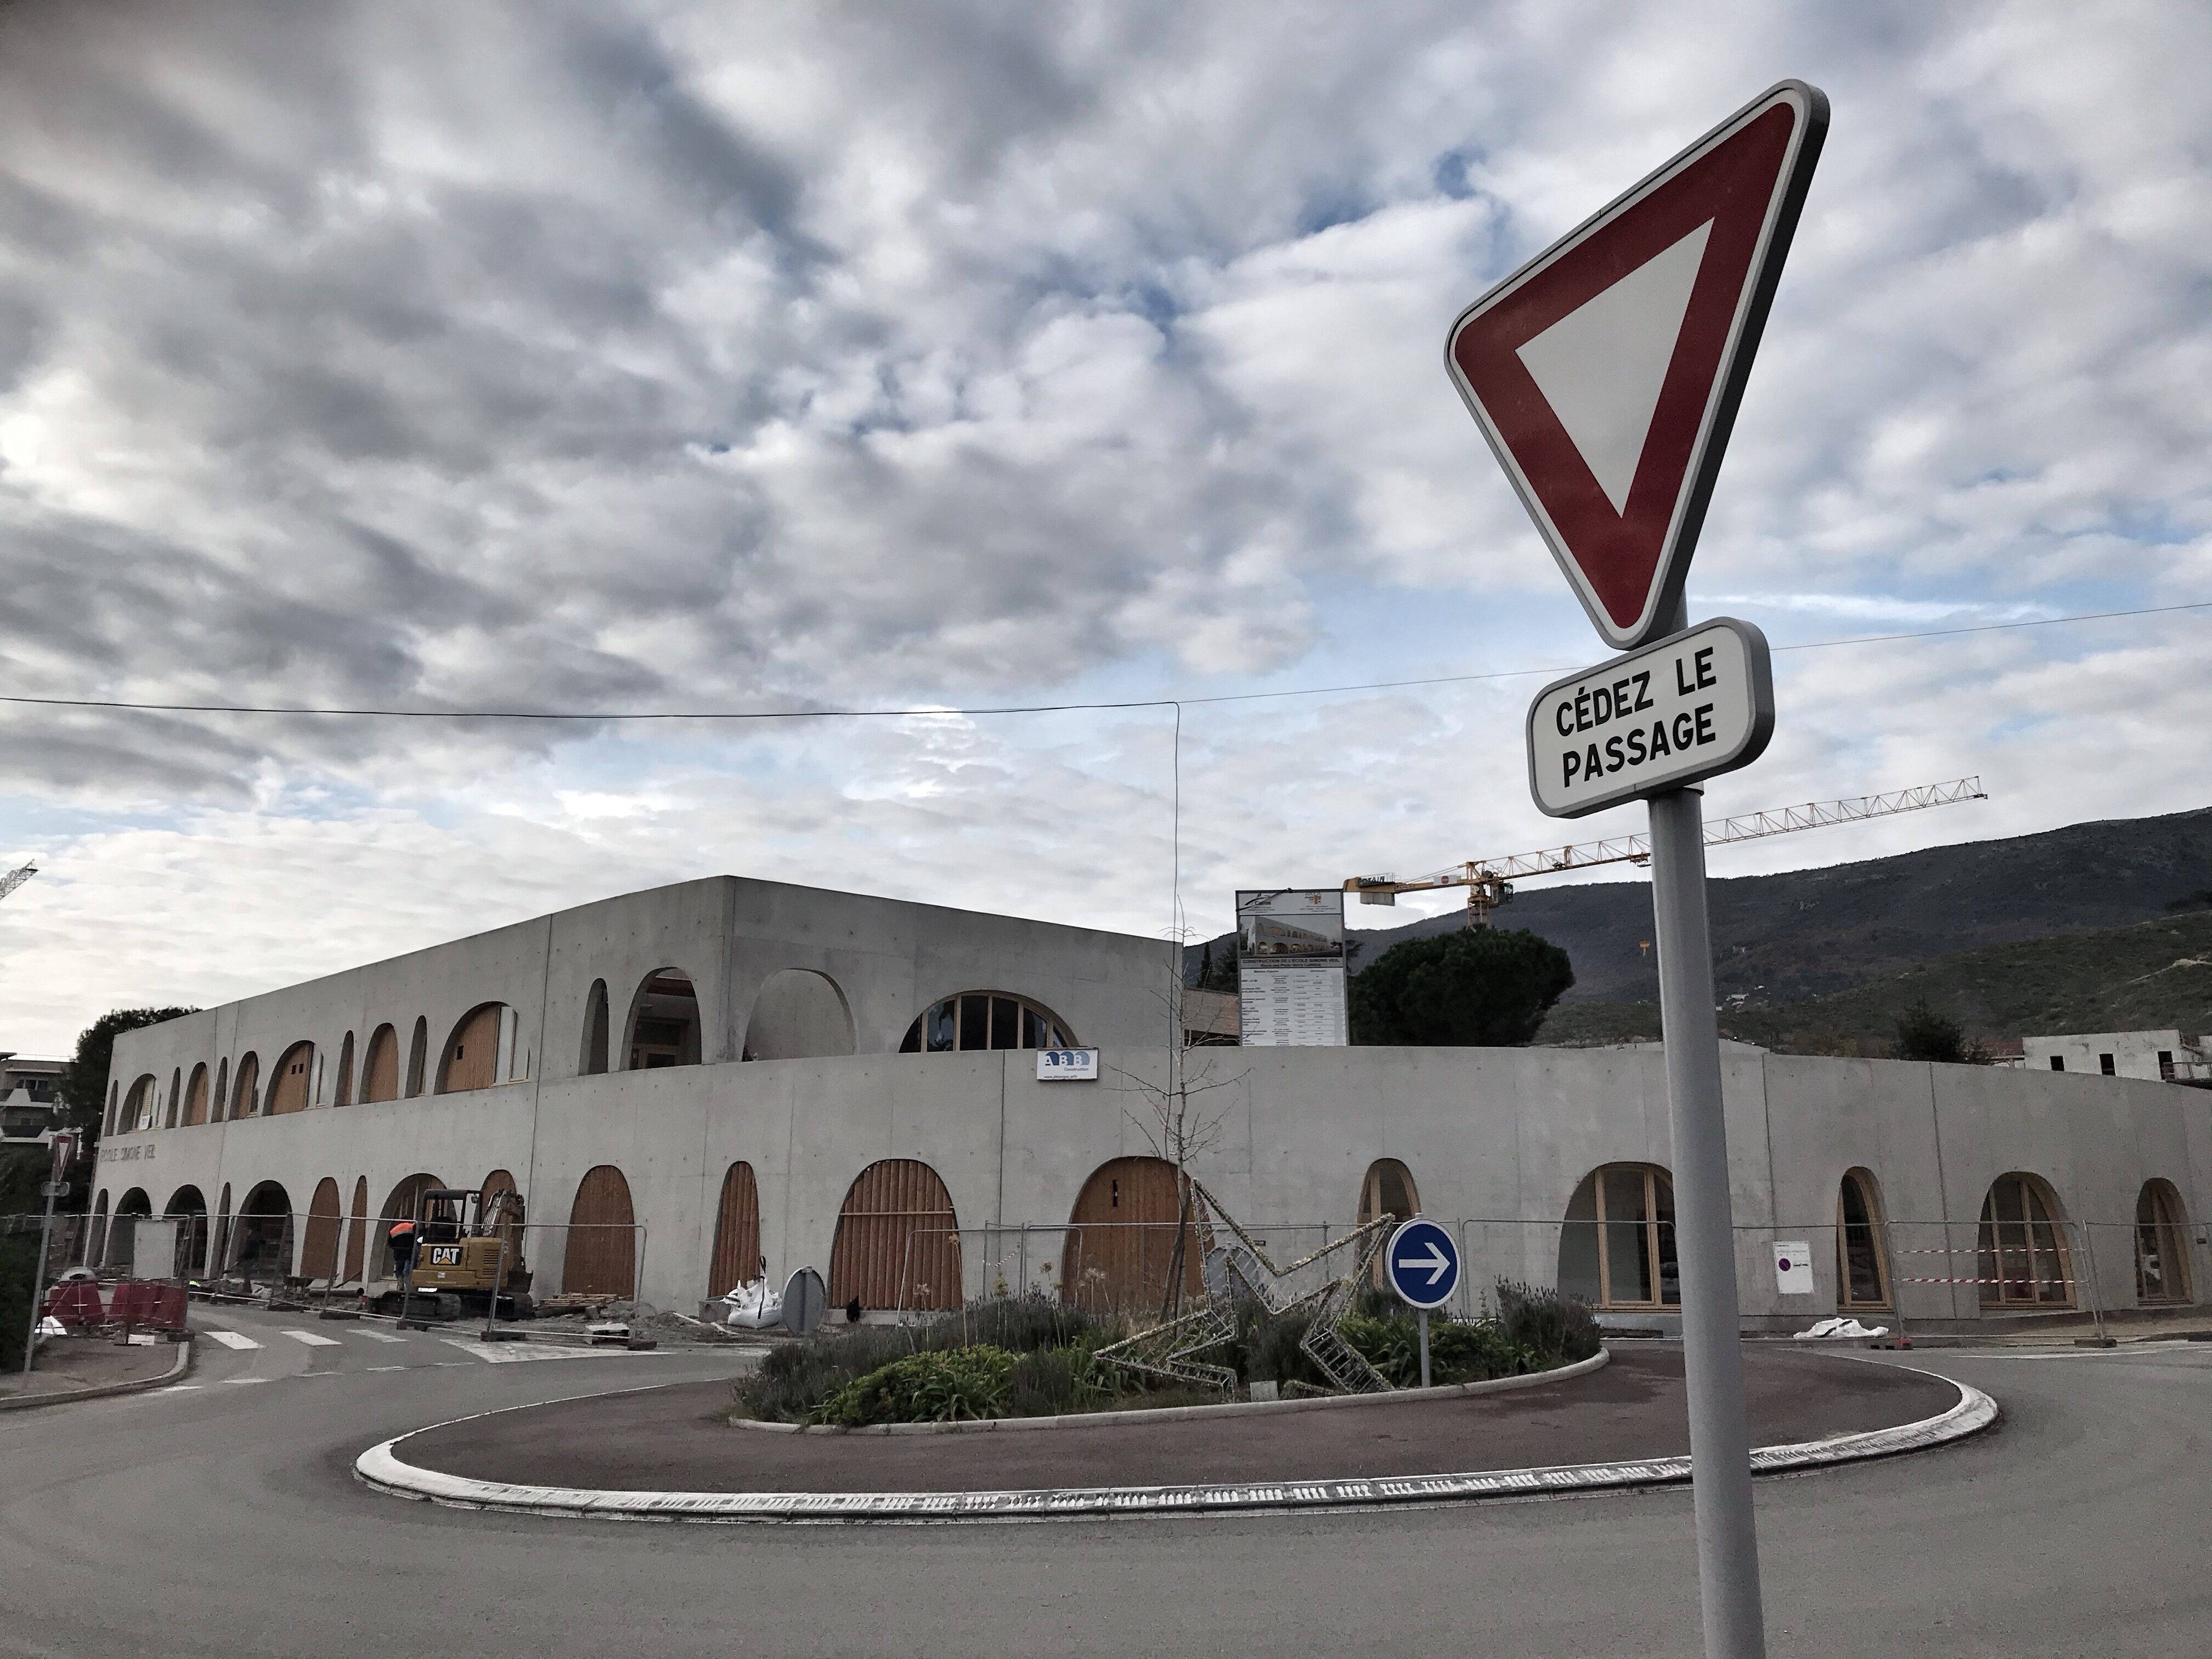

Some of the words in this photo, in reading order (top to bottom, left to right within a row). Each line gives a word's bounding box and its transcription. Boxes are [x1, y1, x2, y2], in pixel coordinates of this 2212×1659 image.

[1556, 670, 1654, 737] CÉDEZ
[1675, 646, 1717, 696] LE
[1562, 703, 1716, 788] PASSAGE
[1043, 1053, 1085, 1065] ABB
[432, 1248, 460, 1265] CAT
